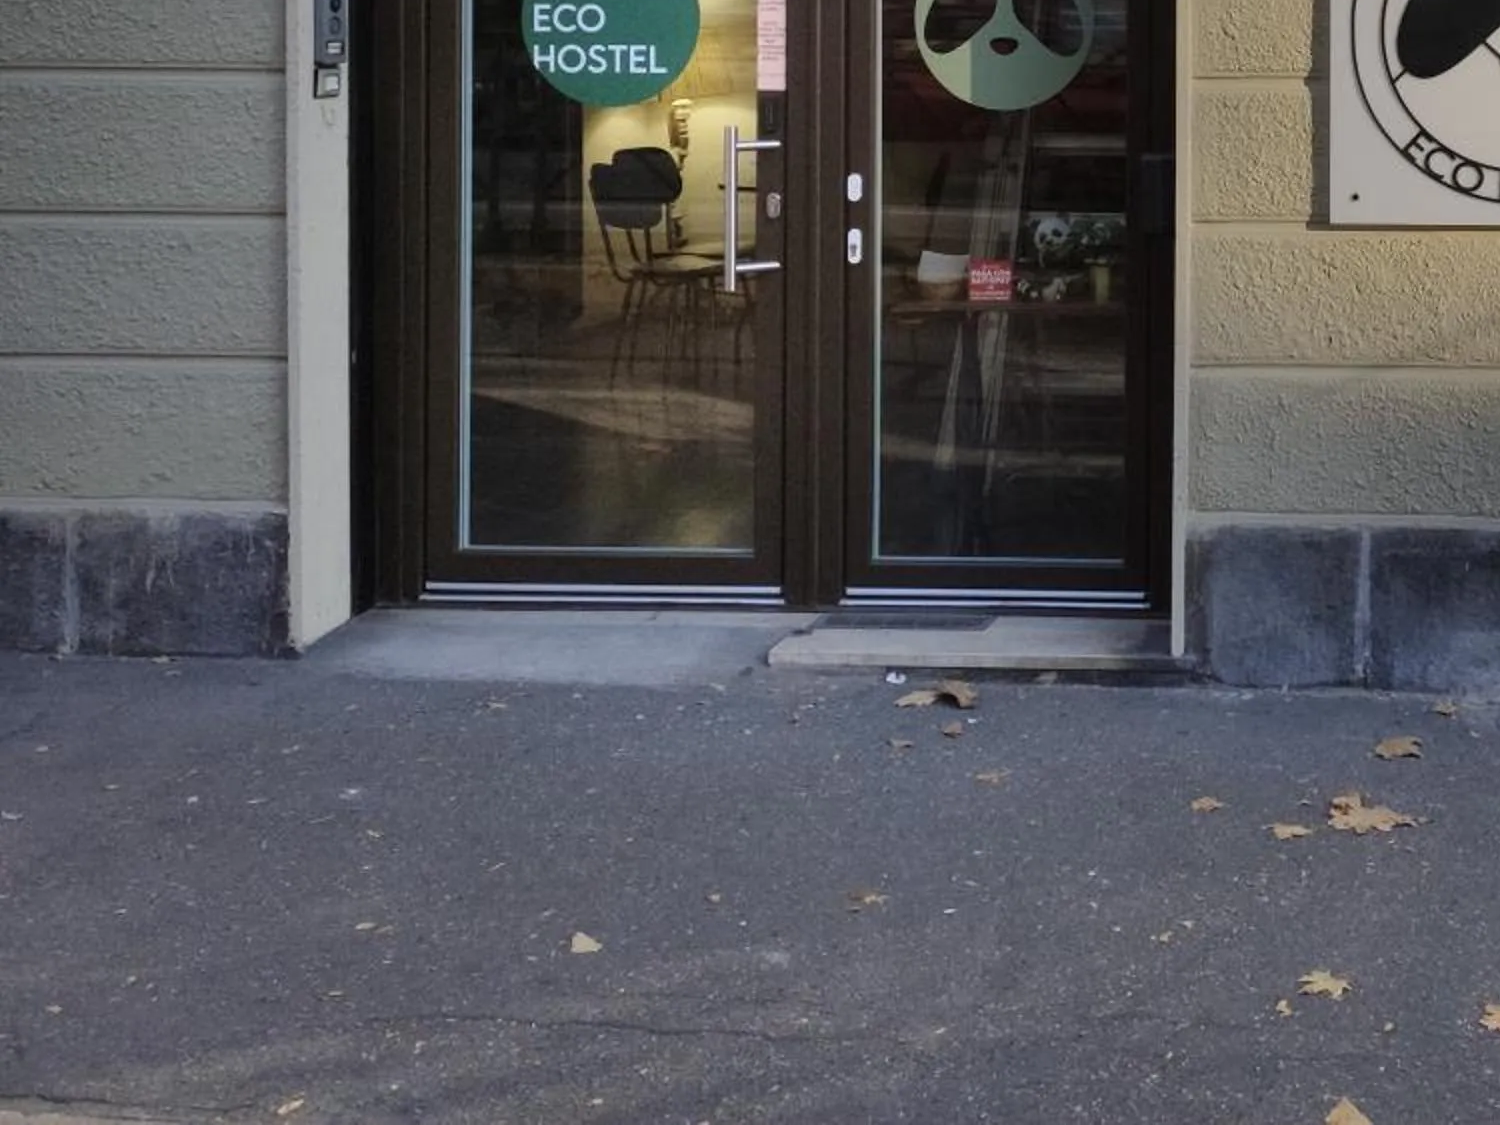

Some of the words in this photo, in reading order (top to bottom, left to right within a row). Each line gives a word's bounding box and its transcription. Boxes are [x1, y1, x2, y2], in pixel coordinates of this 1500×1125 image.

[533, 4, 606, 33] ECO
[533, 44, 668, 74] HOSTEL
[1400, 130, 1484, 194] ECO
